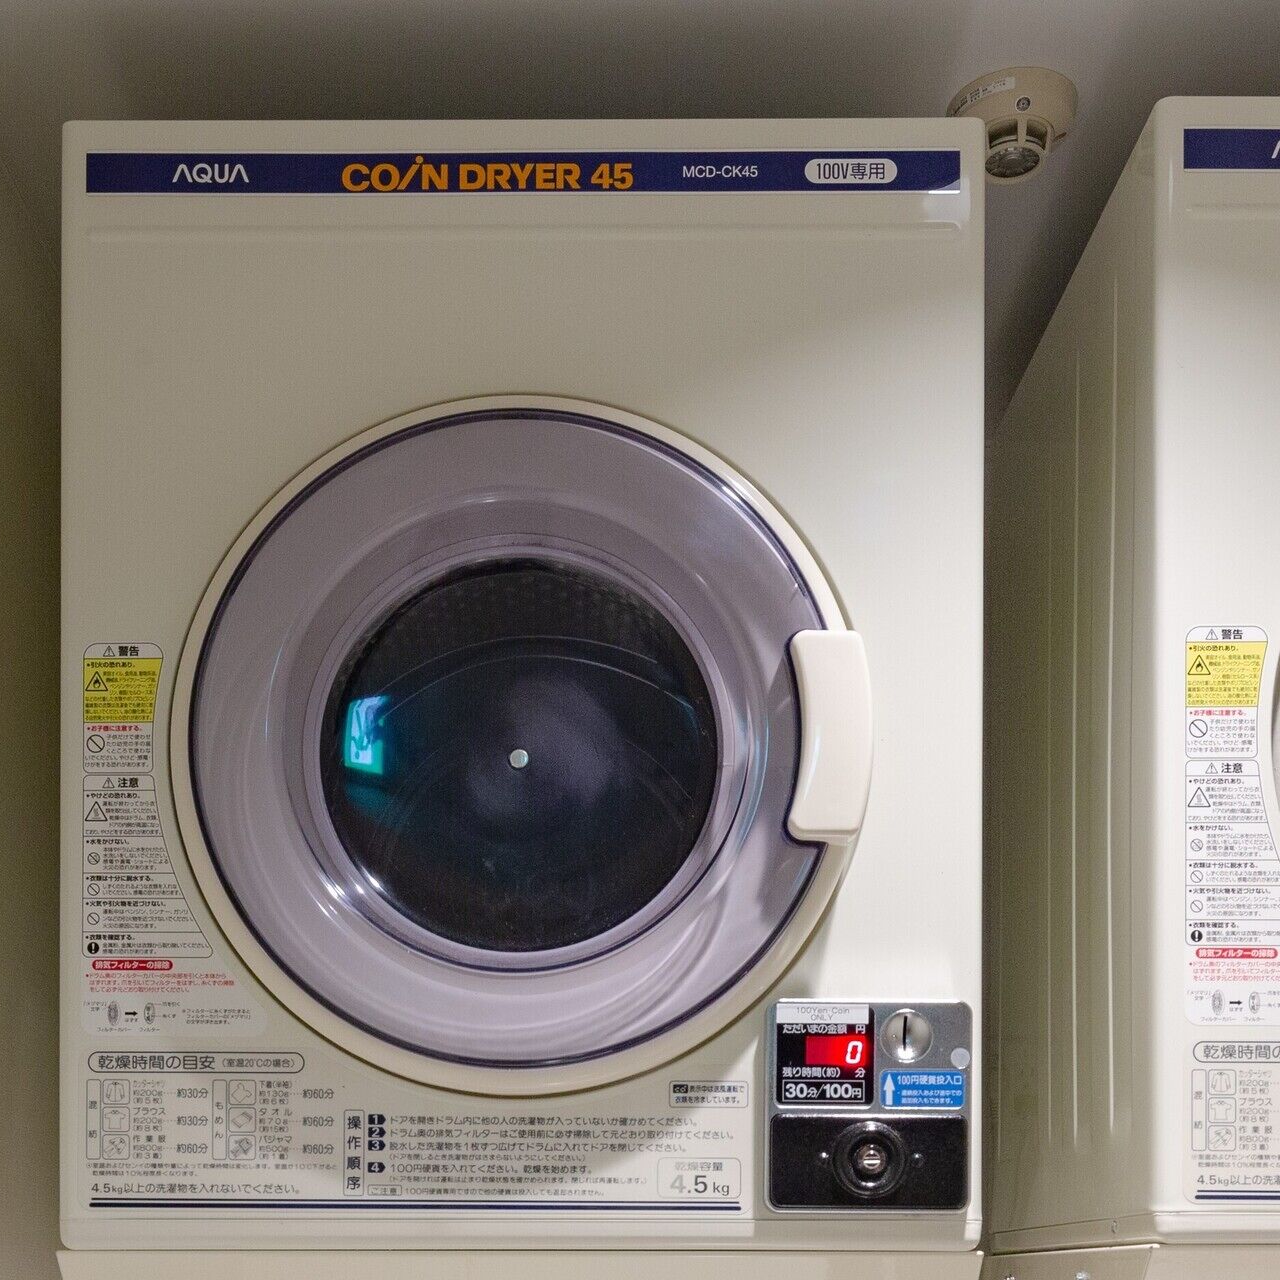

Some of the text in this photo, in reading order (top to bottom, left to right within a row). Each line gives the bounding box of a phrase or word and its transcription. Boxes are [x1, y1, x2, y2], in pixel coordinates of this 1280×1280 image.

[172, 155, 759, 192] AQUA COIN DRYER 45 MCD-CK45
[815, 162, 887, 182] 100V専用
[1221, 629, 1243, 640] 警告
[118, 646, 140, 657] 警告
[1221, 763, 1243, 774] 注意
[117, 777, 139, 788] 注意
[782, 1024, 848, 1034] ただいまの金額
[845, 1040, 863, 1064] 0
[98, 1055, 216, 1070] 乾燥時間の目安
[785, 1083, 863, 1098] 30分/100円
[346, 1116, 361, 1190] 操作順序
